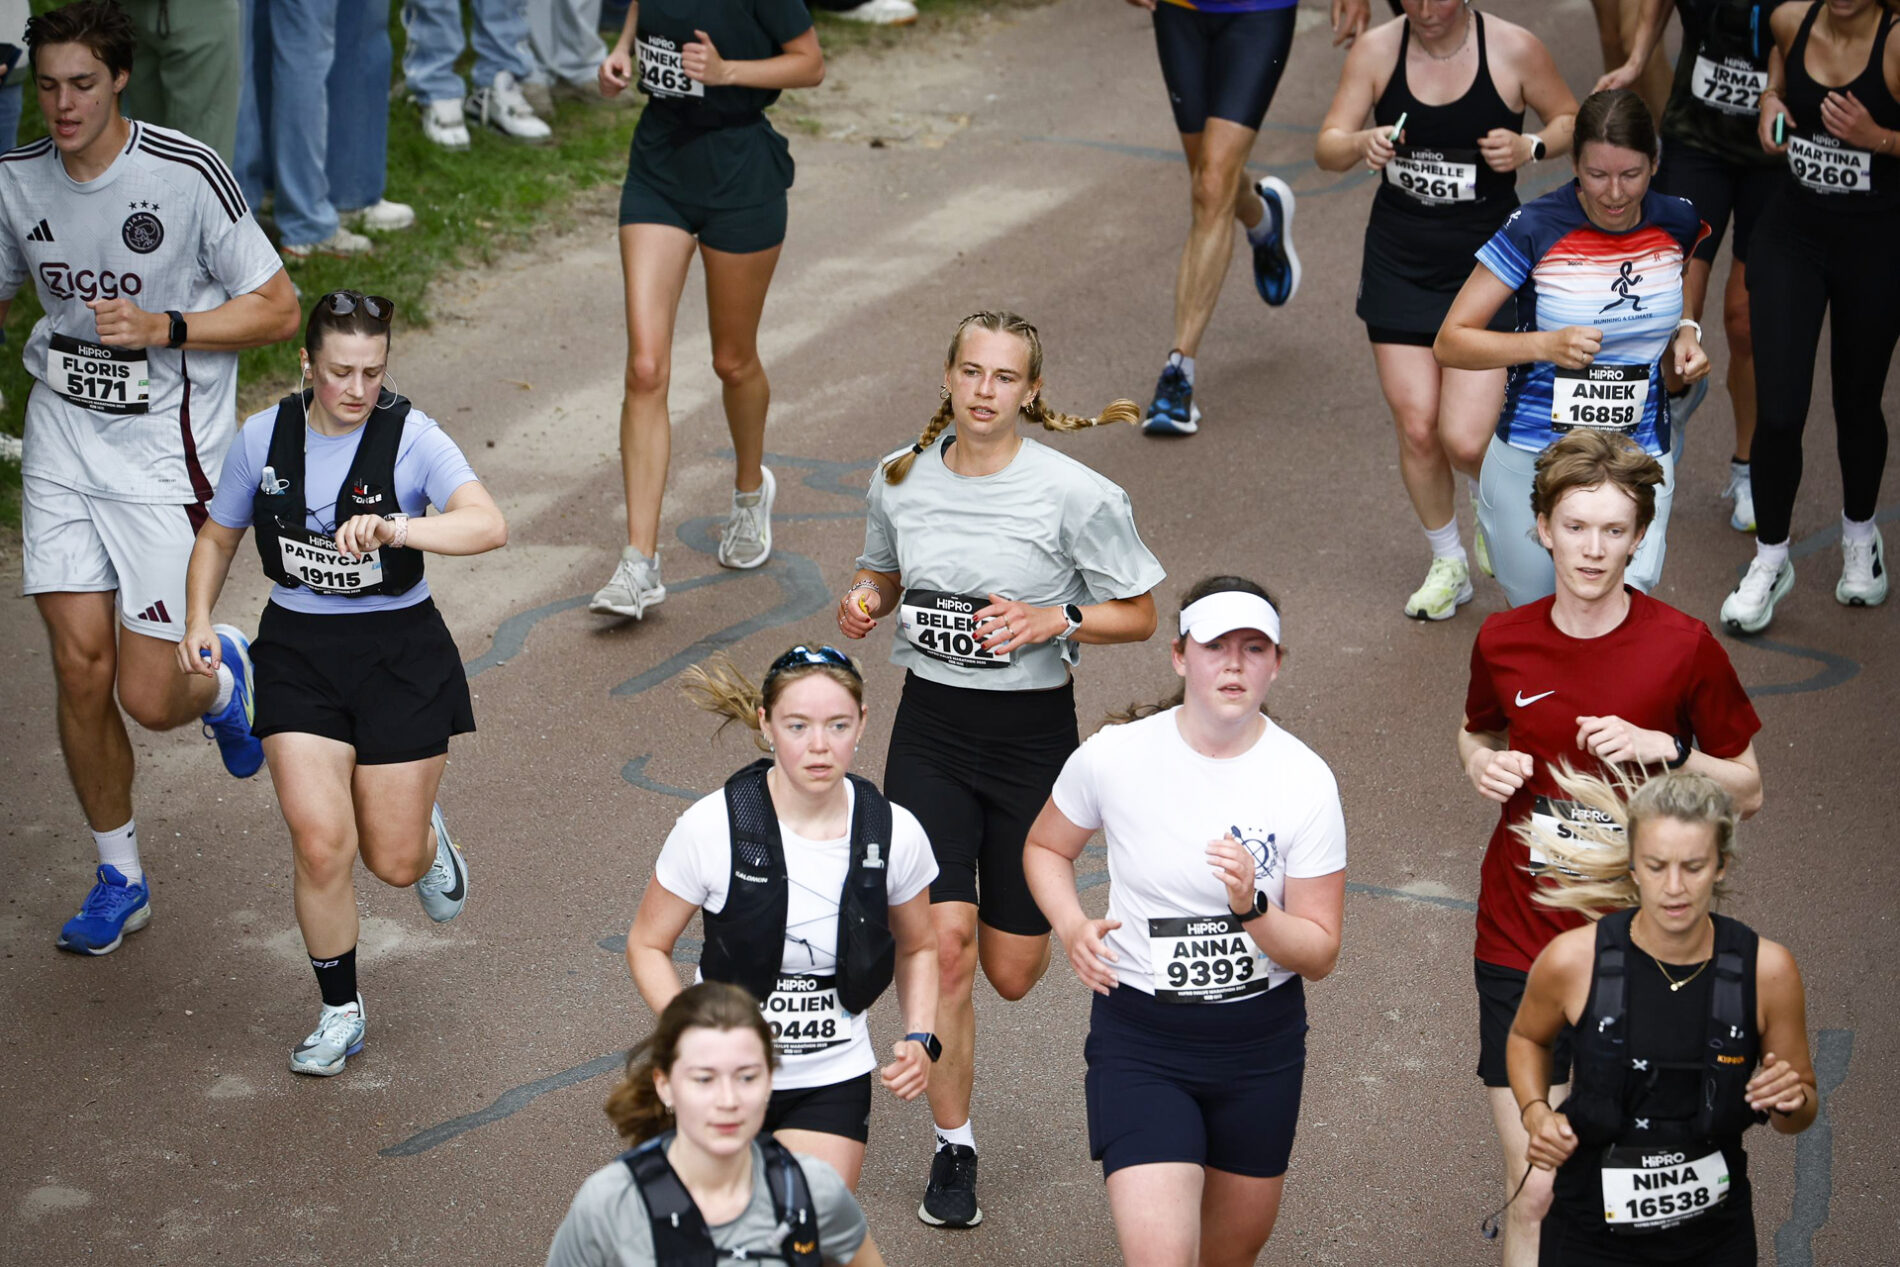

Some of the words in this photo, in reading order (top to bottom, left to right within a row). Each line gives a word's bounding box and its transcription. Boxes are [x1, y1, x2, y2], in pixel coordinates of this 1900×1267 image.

[639, 44, 684, 70] TINEK
[638, 60, 692, 91] 9463
[1712, 65, 1761, 89] IRMA
[1703, 77, 1762, 109] 7227
[1792, 141, 1861, 168] MARTINA
[1394, 160, 1464, 178] MICHELLE
[1793, 158, 1858, 187] 9260
[1399, 171, 1459, 199] 9261
[78, 344, 112, 359] HiPRO
[63, 356, 130, 379] FLORIS
[1589, 369, 1624, 380] HiPRO
[67, 373, 127, 402] 5171
[1572, 383, 1636, 400] ANIEK
[1569, 404, 1635, 424] 16858
[285, 543, 374, 567] PATRYCJA
[300, 566, 361, 588] 19115
[936, 598, 973, 613] HiPRO
[916, 611, 993, 635] BELEK
[1187, 921, 1229, 935] HiPRO
[1173, 937, 1248, 959] ANNA
[1167, 956, 1255, 988] 9393
[776, 979, 818, 992] HiPRO
[1641, 1152, 1686, 1168] HiPRO
[1632, 1166, 1699, 1191] NINA
[1625, 1187, 1710, 1219] 16538
